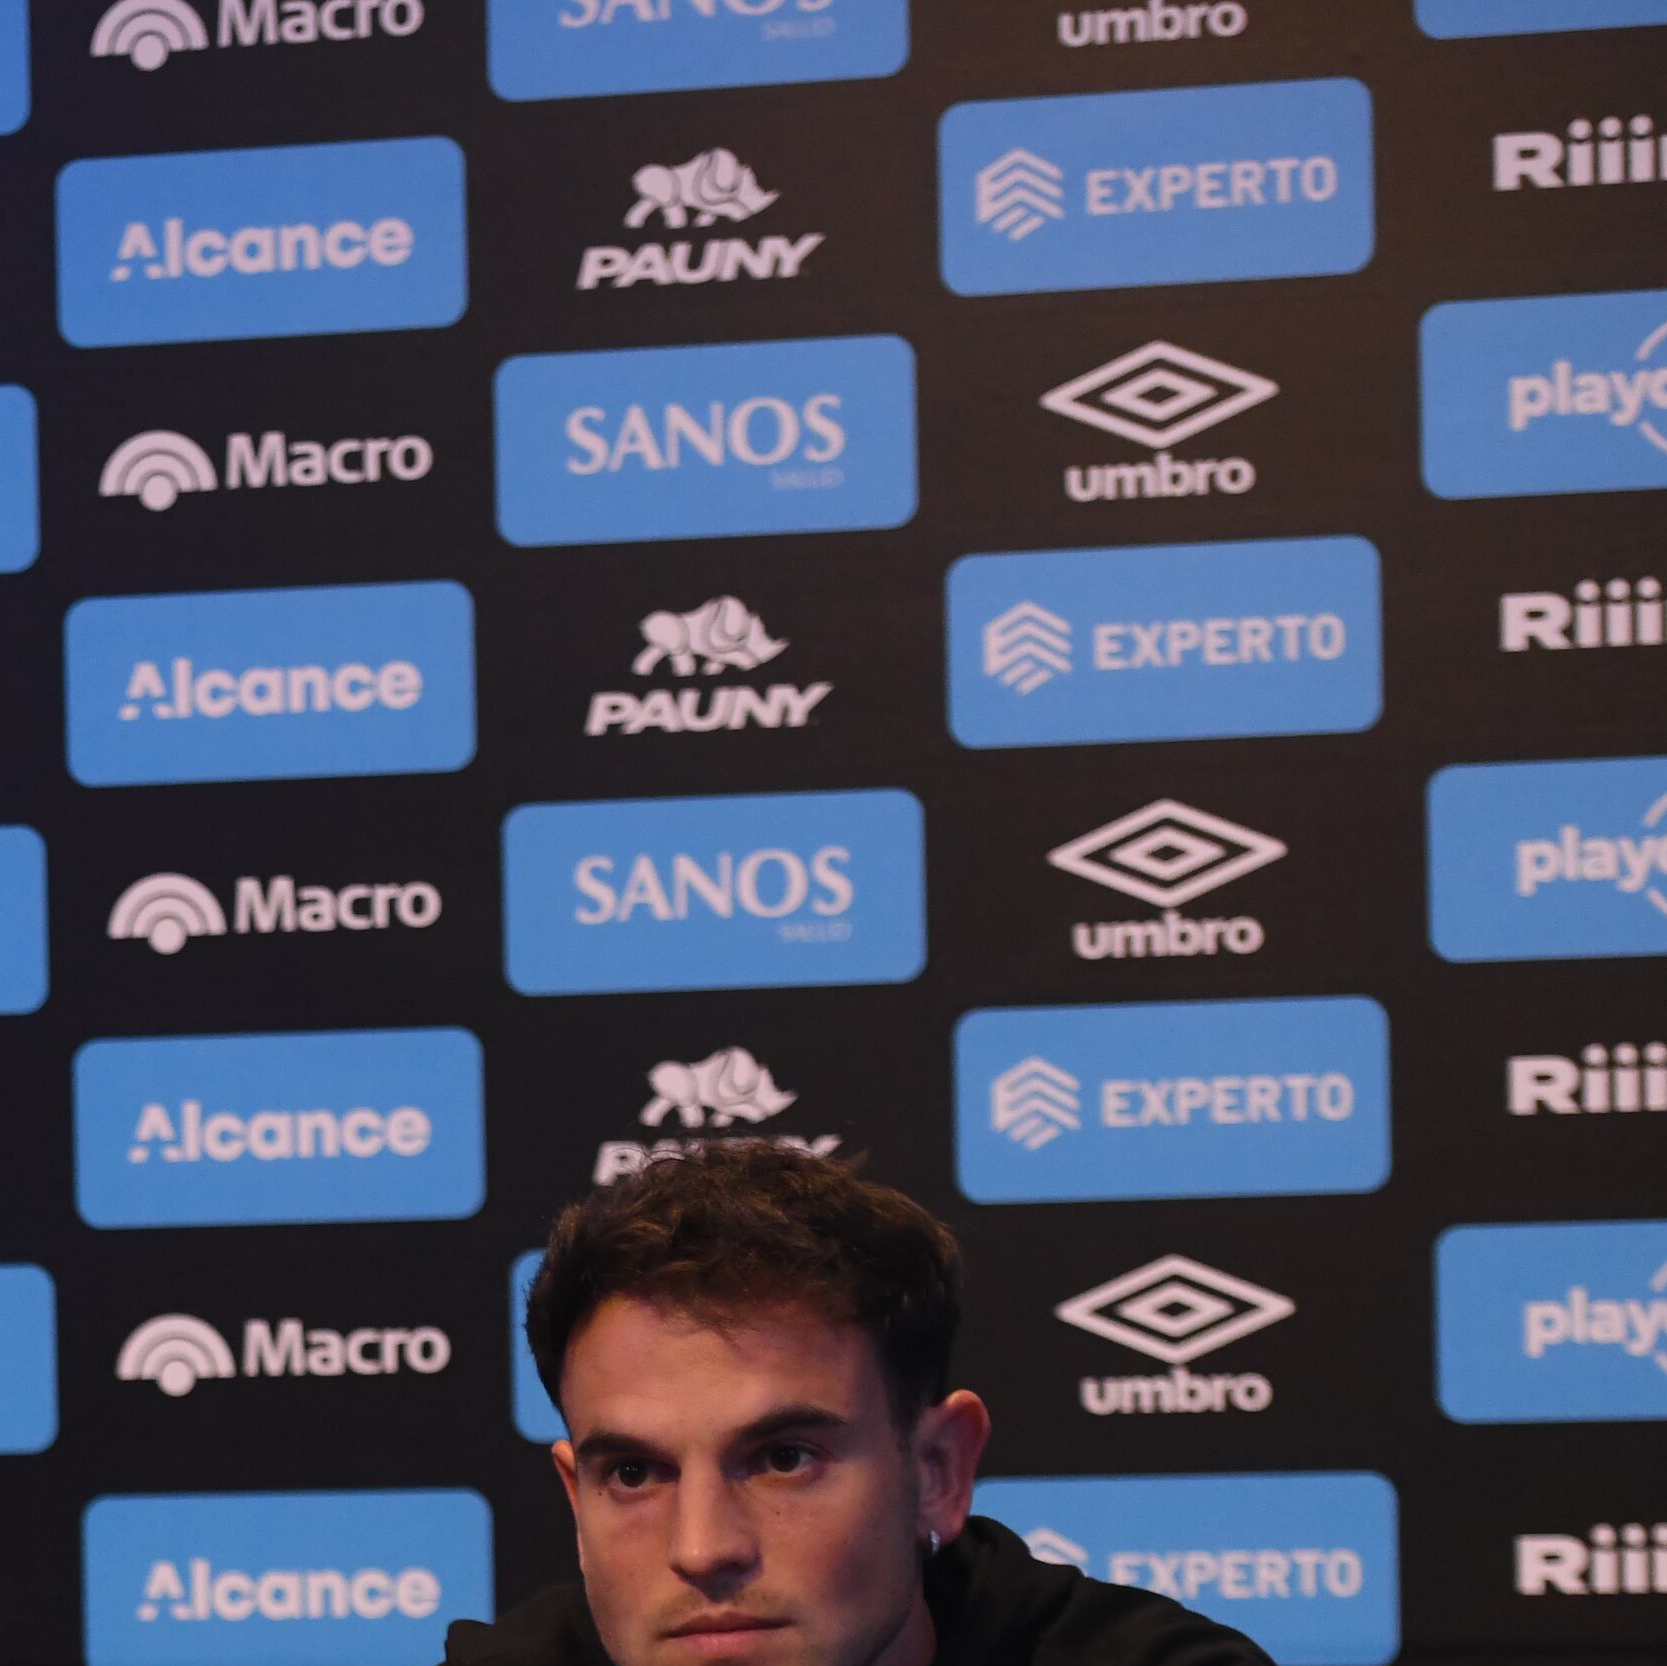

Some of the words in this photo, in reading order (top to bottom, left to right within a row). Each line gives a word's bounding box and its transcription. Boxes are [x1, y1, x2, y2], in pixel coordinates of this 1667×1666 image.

[218, 0, 424, 47] Macro
[1059, 0, 1247, 47] umbro
[1086, 156, 1337, 215] EXPERTO
[112, 218, 414, 281] Alcance
[578, 234, 823, 289] PAUNY
[227, 432, 432, 489] Macro
[567, 394, 845, 474] SANOS
[1066, 452, 1255, 502] umbro
[1093, 614, 1345, 670] EXPERTO
[120, 658, 422, 720] Alcance
[587, 683, 831, 736] PAUNY
[575, 847, 853, 924] SANOS
[1517, 823, 1667, 895] play
[235, 876, 441, 933] Macro
[1074, 910, 1264, 960] umbro
[1102, 1073, 1354, 1128] EXPERTO
[129, 1101, 431, 1163] Alcance
[244, 1319, 450, 1377] Macro
[1082, 1366, 1272, 1415] umbro
[138, 1559, 440, 1621] Alcance
[1109, 1549, 1363, 1599] EXPERTO
